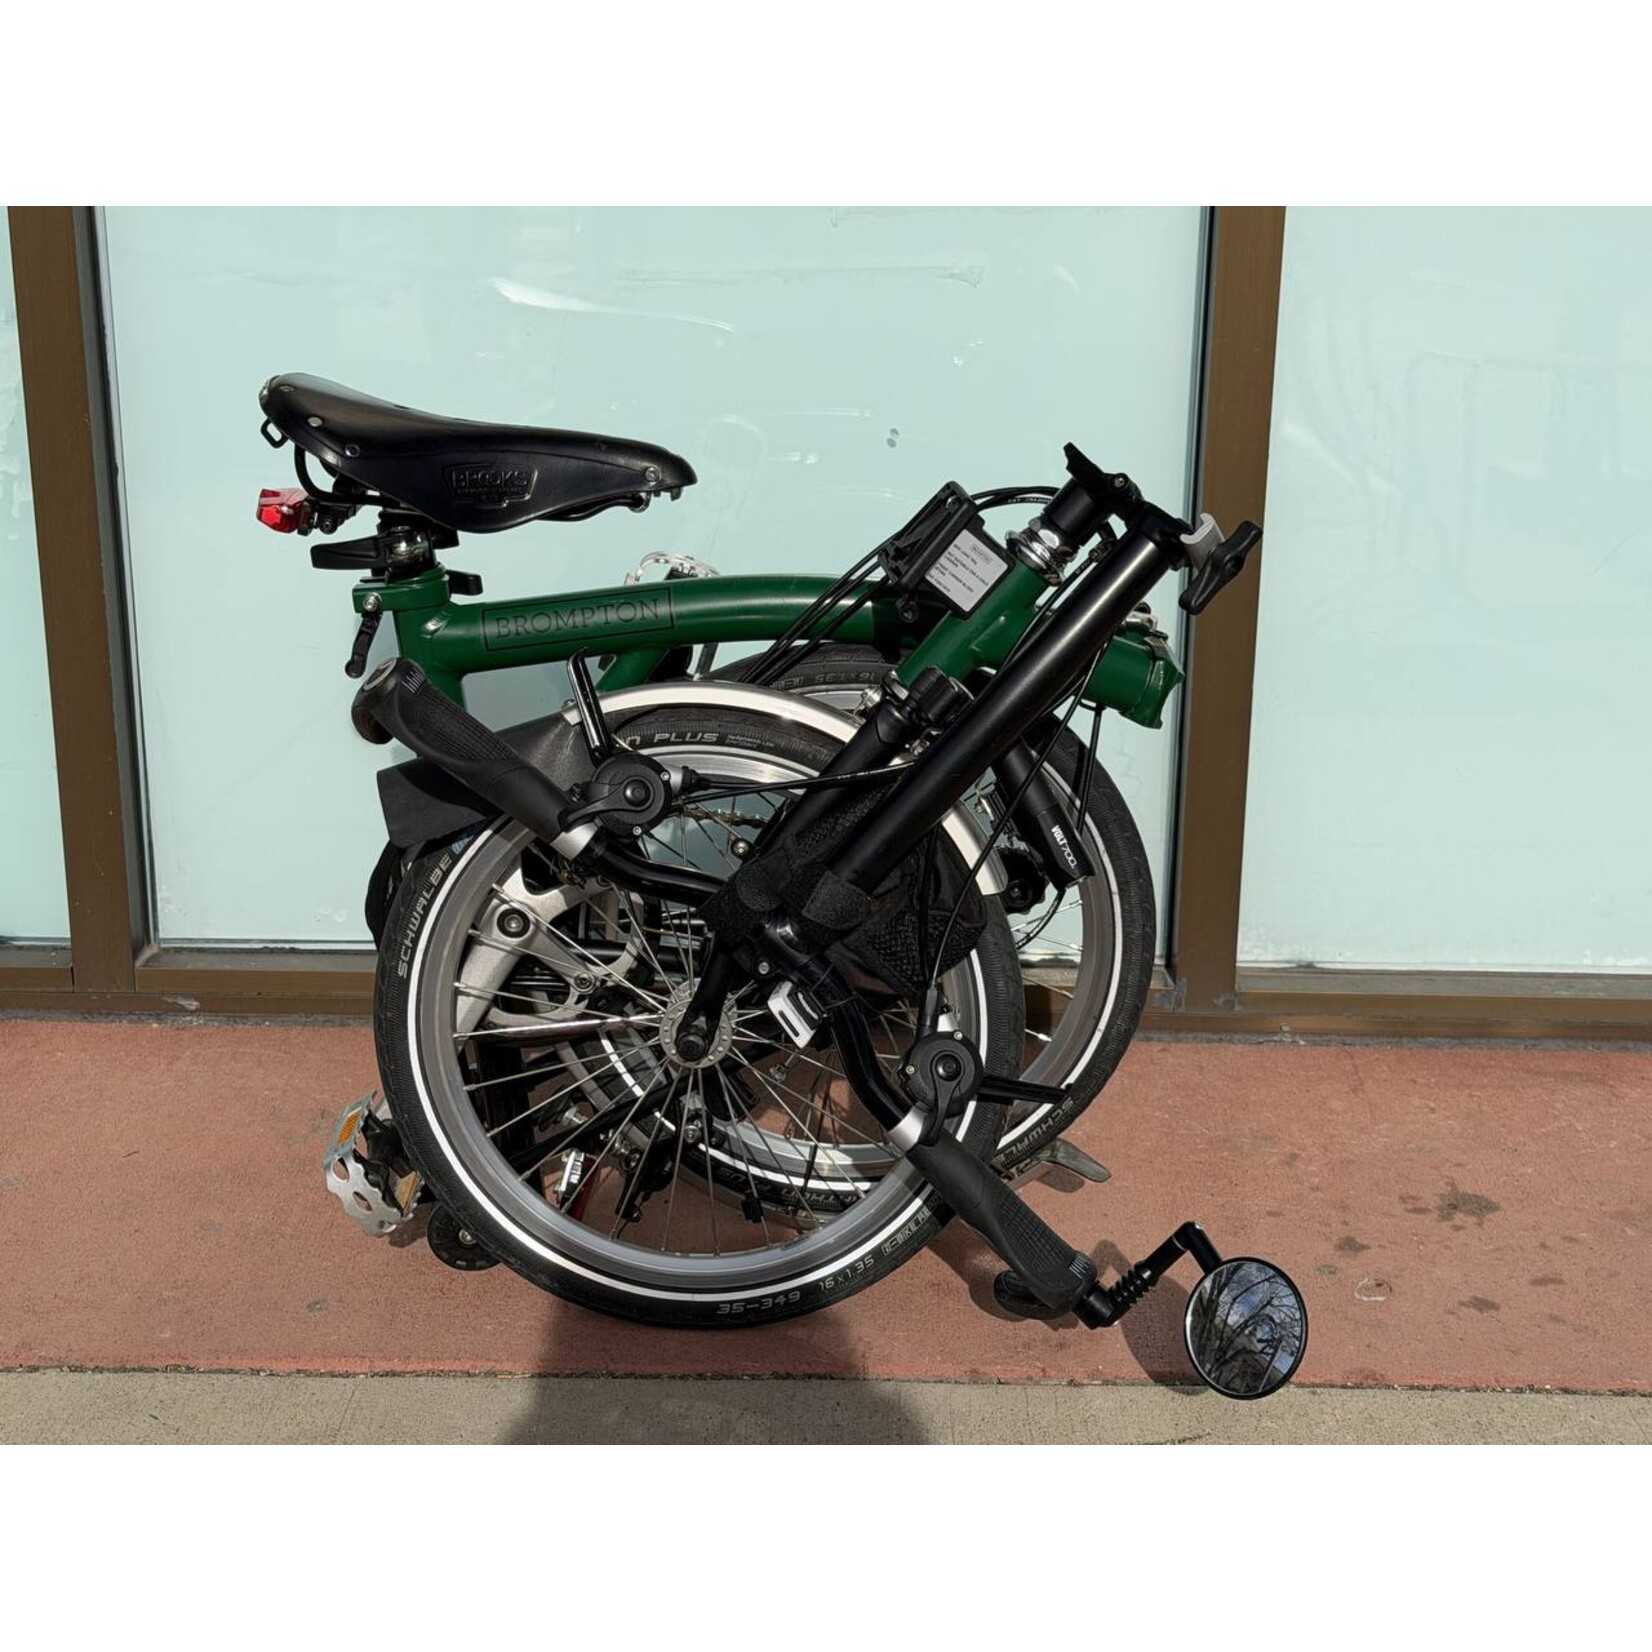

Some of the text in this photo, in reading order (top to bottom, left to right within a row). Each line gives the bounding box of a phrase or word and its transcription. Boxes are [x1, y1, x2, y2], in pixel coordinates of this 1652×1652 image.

[495, 599, 659, 640] BROMPTON
[653, 732, 719, 743] PLUS
[398, 852, 452, 979] SCHWALBE
[717, 1290, 800, 1315] 35-349
[819, 1276, 835, 1291] 16
